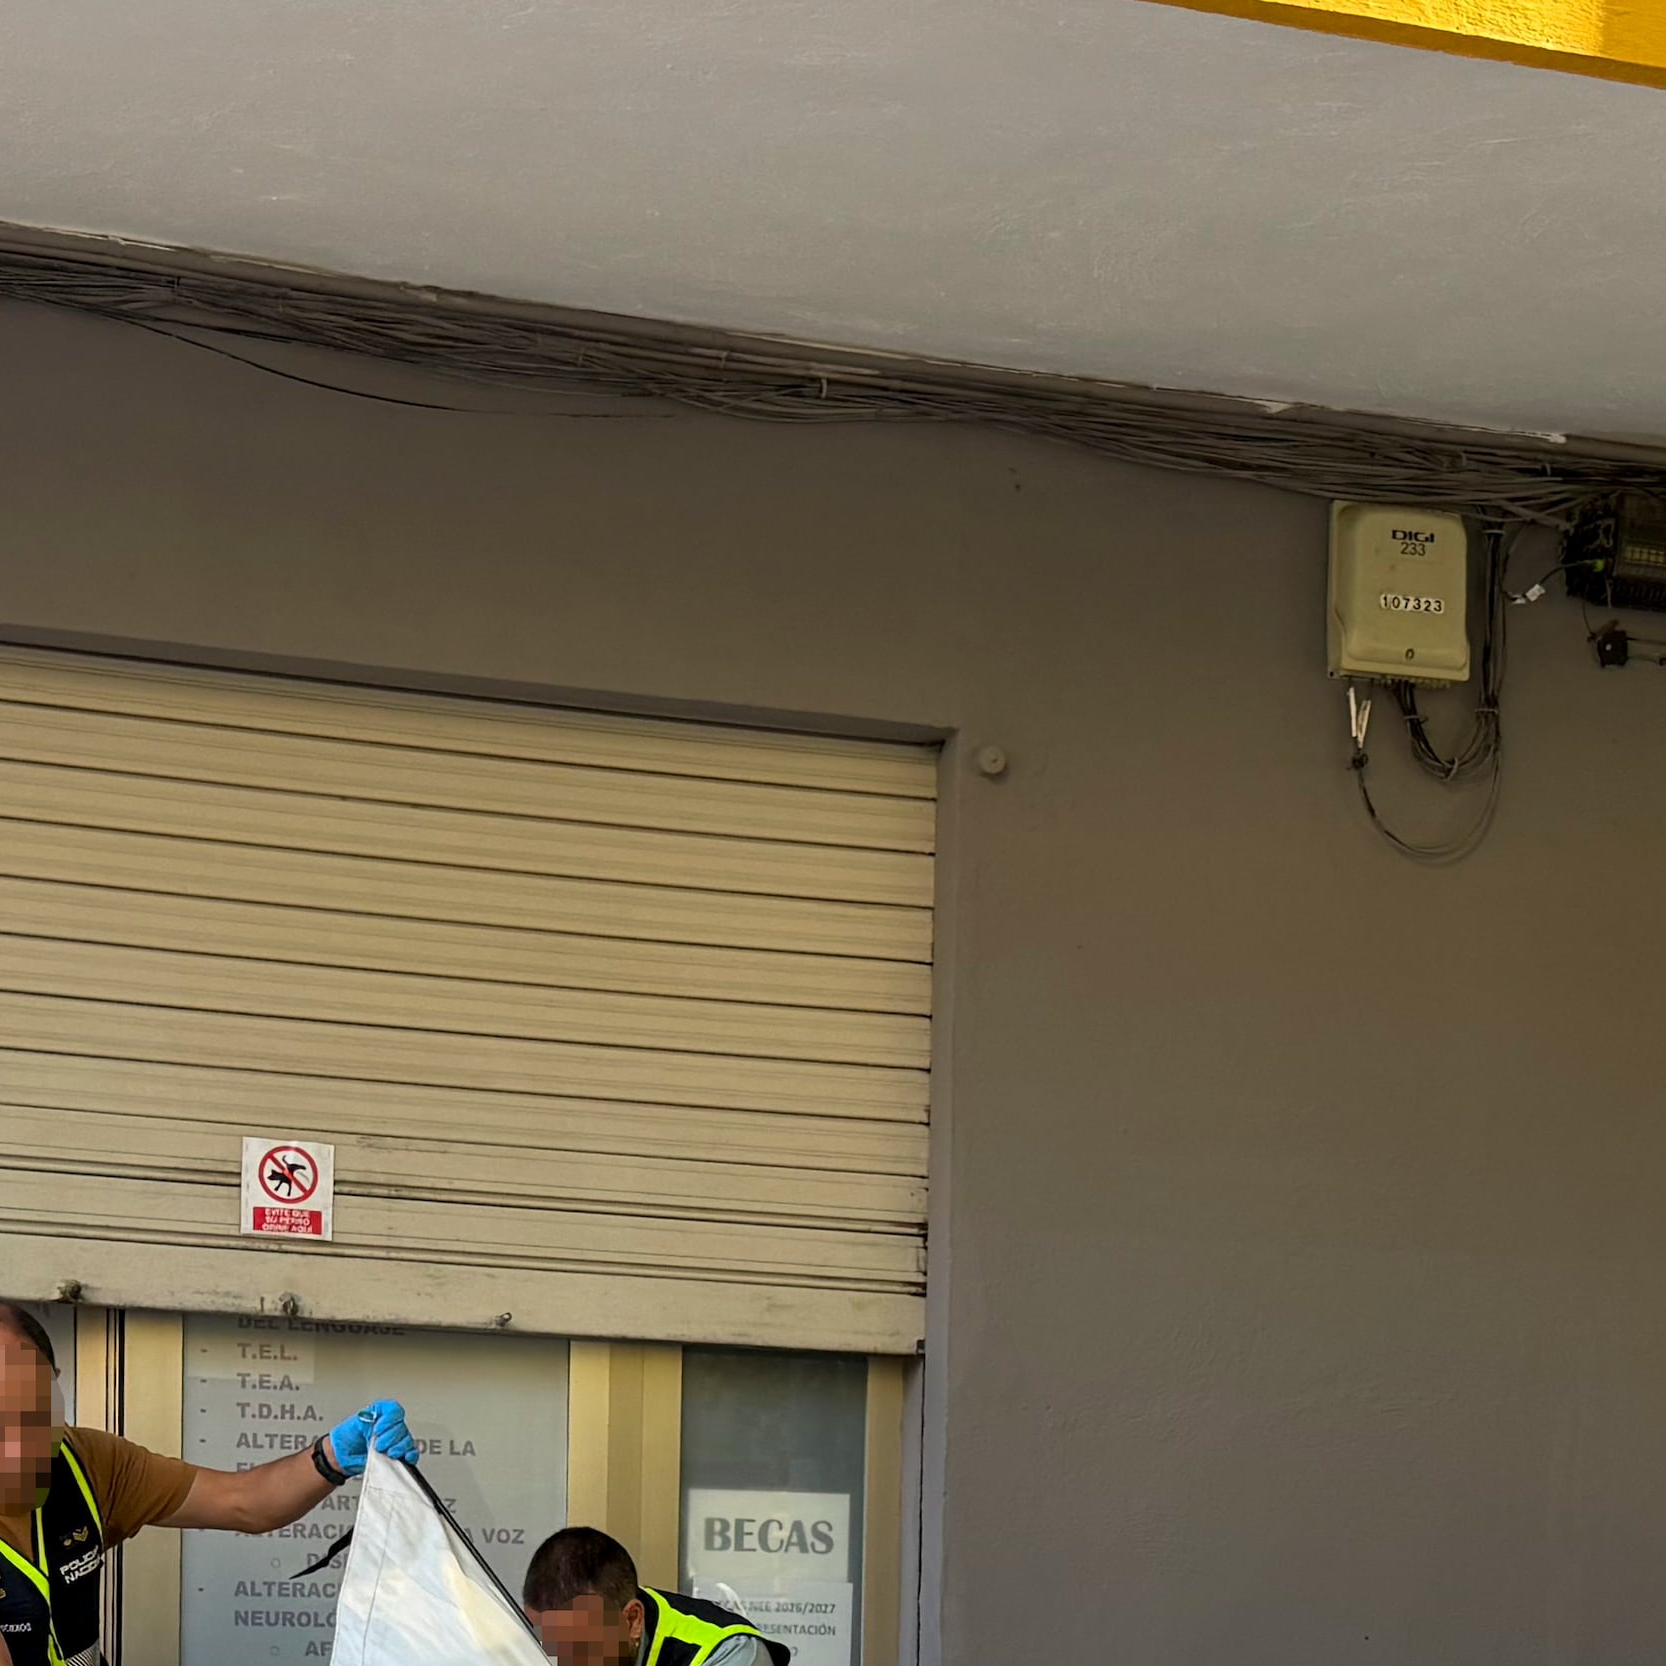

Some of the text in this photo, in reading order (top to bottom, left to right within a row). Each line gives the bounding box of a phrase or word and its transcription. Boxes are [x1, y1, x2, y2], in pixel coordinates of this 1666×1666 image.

[1392, 529, 1436, 544] DIGI
[1400, 542, 1426, 557] 233
[1382, 596, 1443, 614] 107323
[237, 1343, 298, 1361] T.E.L.
[237, 1373, 300, 1391] T.E.A.
[237, 1402, 324, 1422] T.D.H.A.
[450, 1439, 476, 1456] LA
[482, 1528, 525, 1544] VOZ
[705, 1517, 834, 1555] BECAS
